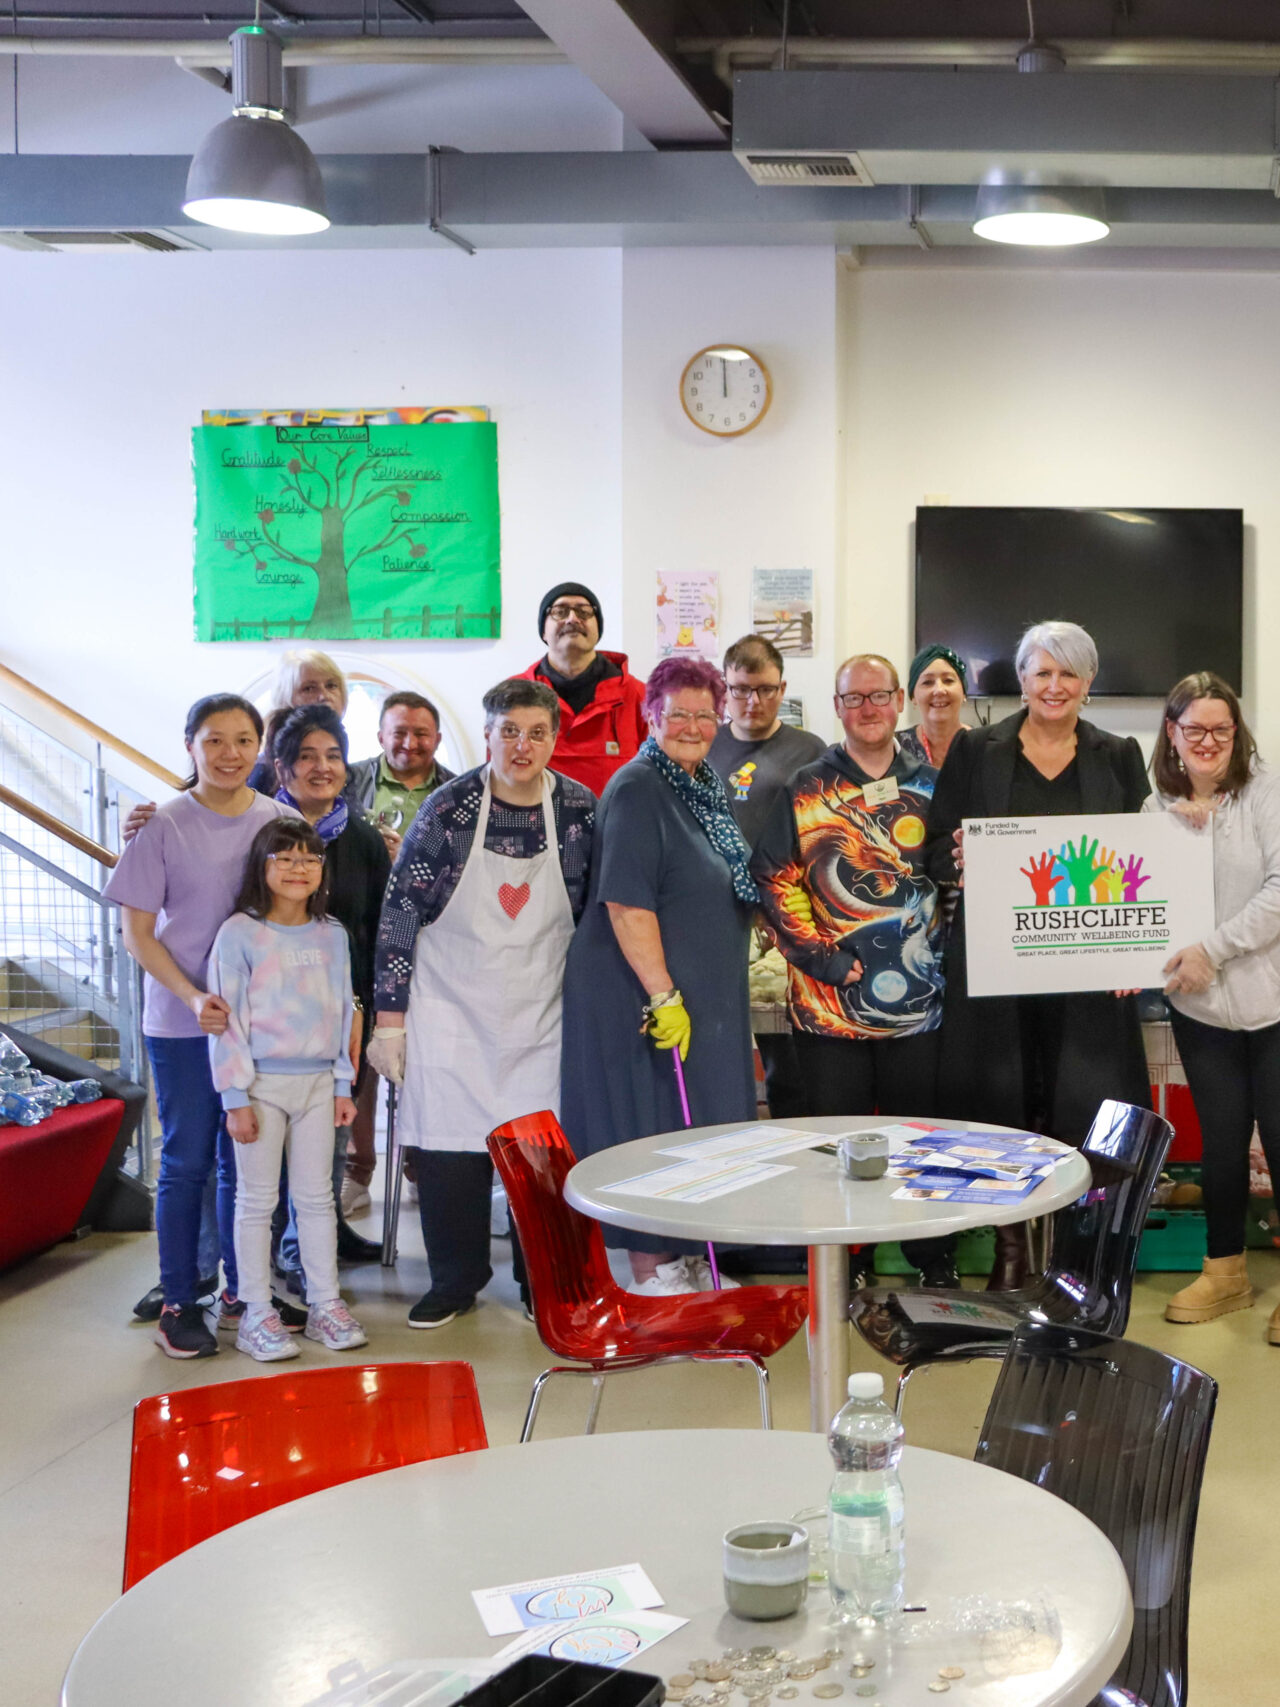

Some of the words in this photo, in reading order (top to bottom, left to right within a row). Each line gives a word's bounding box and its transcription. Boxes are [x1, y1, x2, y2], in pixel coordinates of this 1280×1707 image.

[279, 427, 302, 440] Our
[222, 447, 285, 467] Gratitude
[390, 504, 468, 524] Compassion
[382, 555, 432, 570] Patience
[1014, 907, 1167, 931] RUSHCLIFFE
[1011, 932, 1077, 944] COMMUNITY
[1081, 929, 1140, 940] WELLBEING
[1142, 928, 1170, 938] FUND
